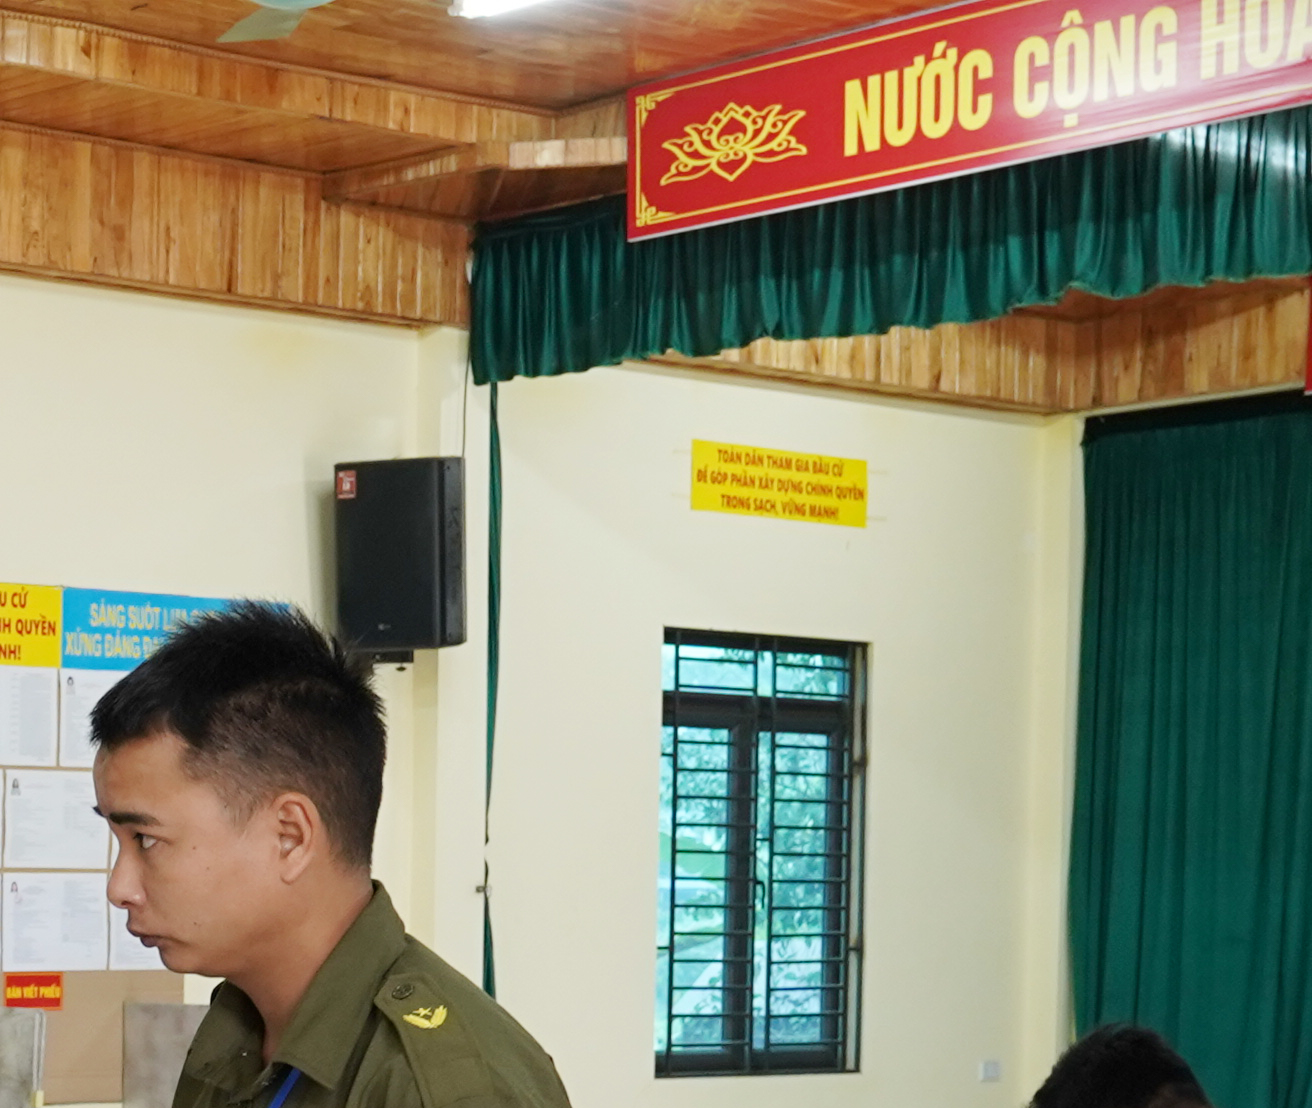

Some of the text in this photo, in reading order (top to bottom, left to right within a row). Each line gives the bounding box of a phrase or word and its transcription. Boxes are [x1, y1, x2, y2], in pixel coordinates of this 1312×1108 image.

[844, 41, 993, 157] NƯỚC
[1013, 7, 1177, 128] CỘNG
[718, 447, 845, 477] TOÀN DÂN THAM GIA BẦU CỬ
[697, 465, 864, 502] ĐỂ GÓP PHẦN XÂY DỰNG CHÍNH QUYỀN
[11, 586, 28, 608] CỬ
[15, 614, 56, 636] QUYỀN
[90, 598, 126, 628] SÁNG
[128, 601, 160, 629] SUỐT
[64, 627, 102, 656] XỨNG
[105, 629, 141, 658] ĐÁNG
